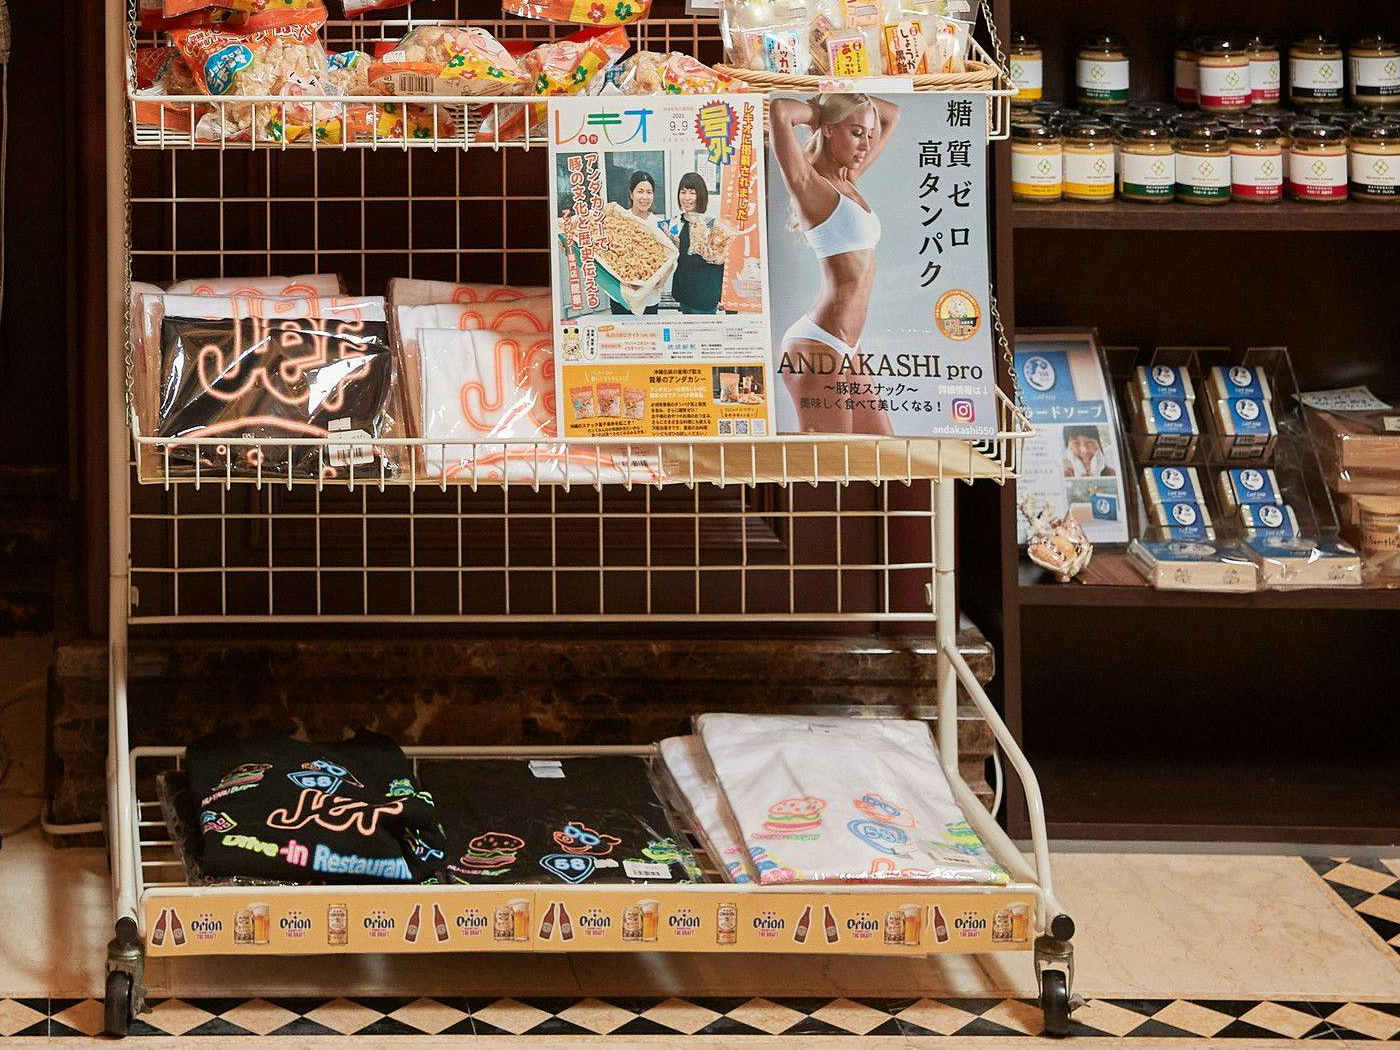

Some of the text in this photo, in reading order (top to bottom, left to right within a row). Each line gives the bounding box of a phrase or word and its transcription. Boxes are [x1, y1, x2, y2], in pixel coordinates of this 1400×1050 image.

[554, 108, 653, 146] レキオ
[669, 121, 688, 132] 9.9
[700, 103, 735, 165] 号外
[947, 100, 973, 247] 糖質ゼロ
[585, 153, 609, 250] アンダカシーで
[917, 140, 943, 288] 高タンパク
[568, 156, 599, 307] 豚の文化と歴史伝える
[777, 352, 983, 380] ANDAKASHI pro
[800, 398, 942, 413] 美味しく食べて美しくなる！
[932, 425, 995, 436] andakashi550
[302, 775, 331, 787] 58
[222, 835, 309, 866] Drive-in
[314, 844, 413, 880] Restauran
[555, 857, 586, 870] 58
[192, 918, 222, 933] Orion
[280, 917, 311, 931] Orion
[364, 917, 395, 930] Orion
[456, 915, 487, 929] Orion
[579, 914, 610, 929] Orion
[669, 914, 700, 929] Orion
[753, 915, 784, 929] Orion
[847, 916, 878, 930] Orion
[955, 915, 986, 929] Orion
